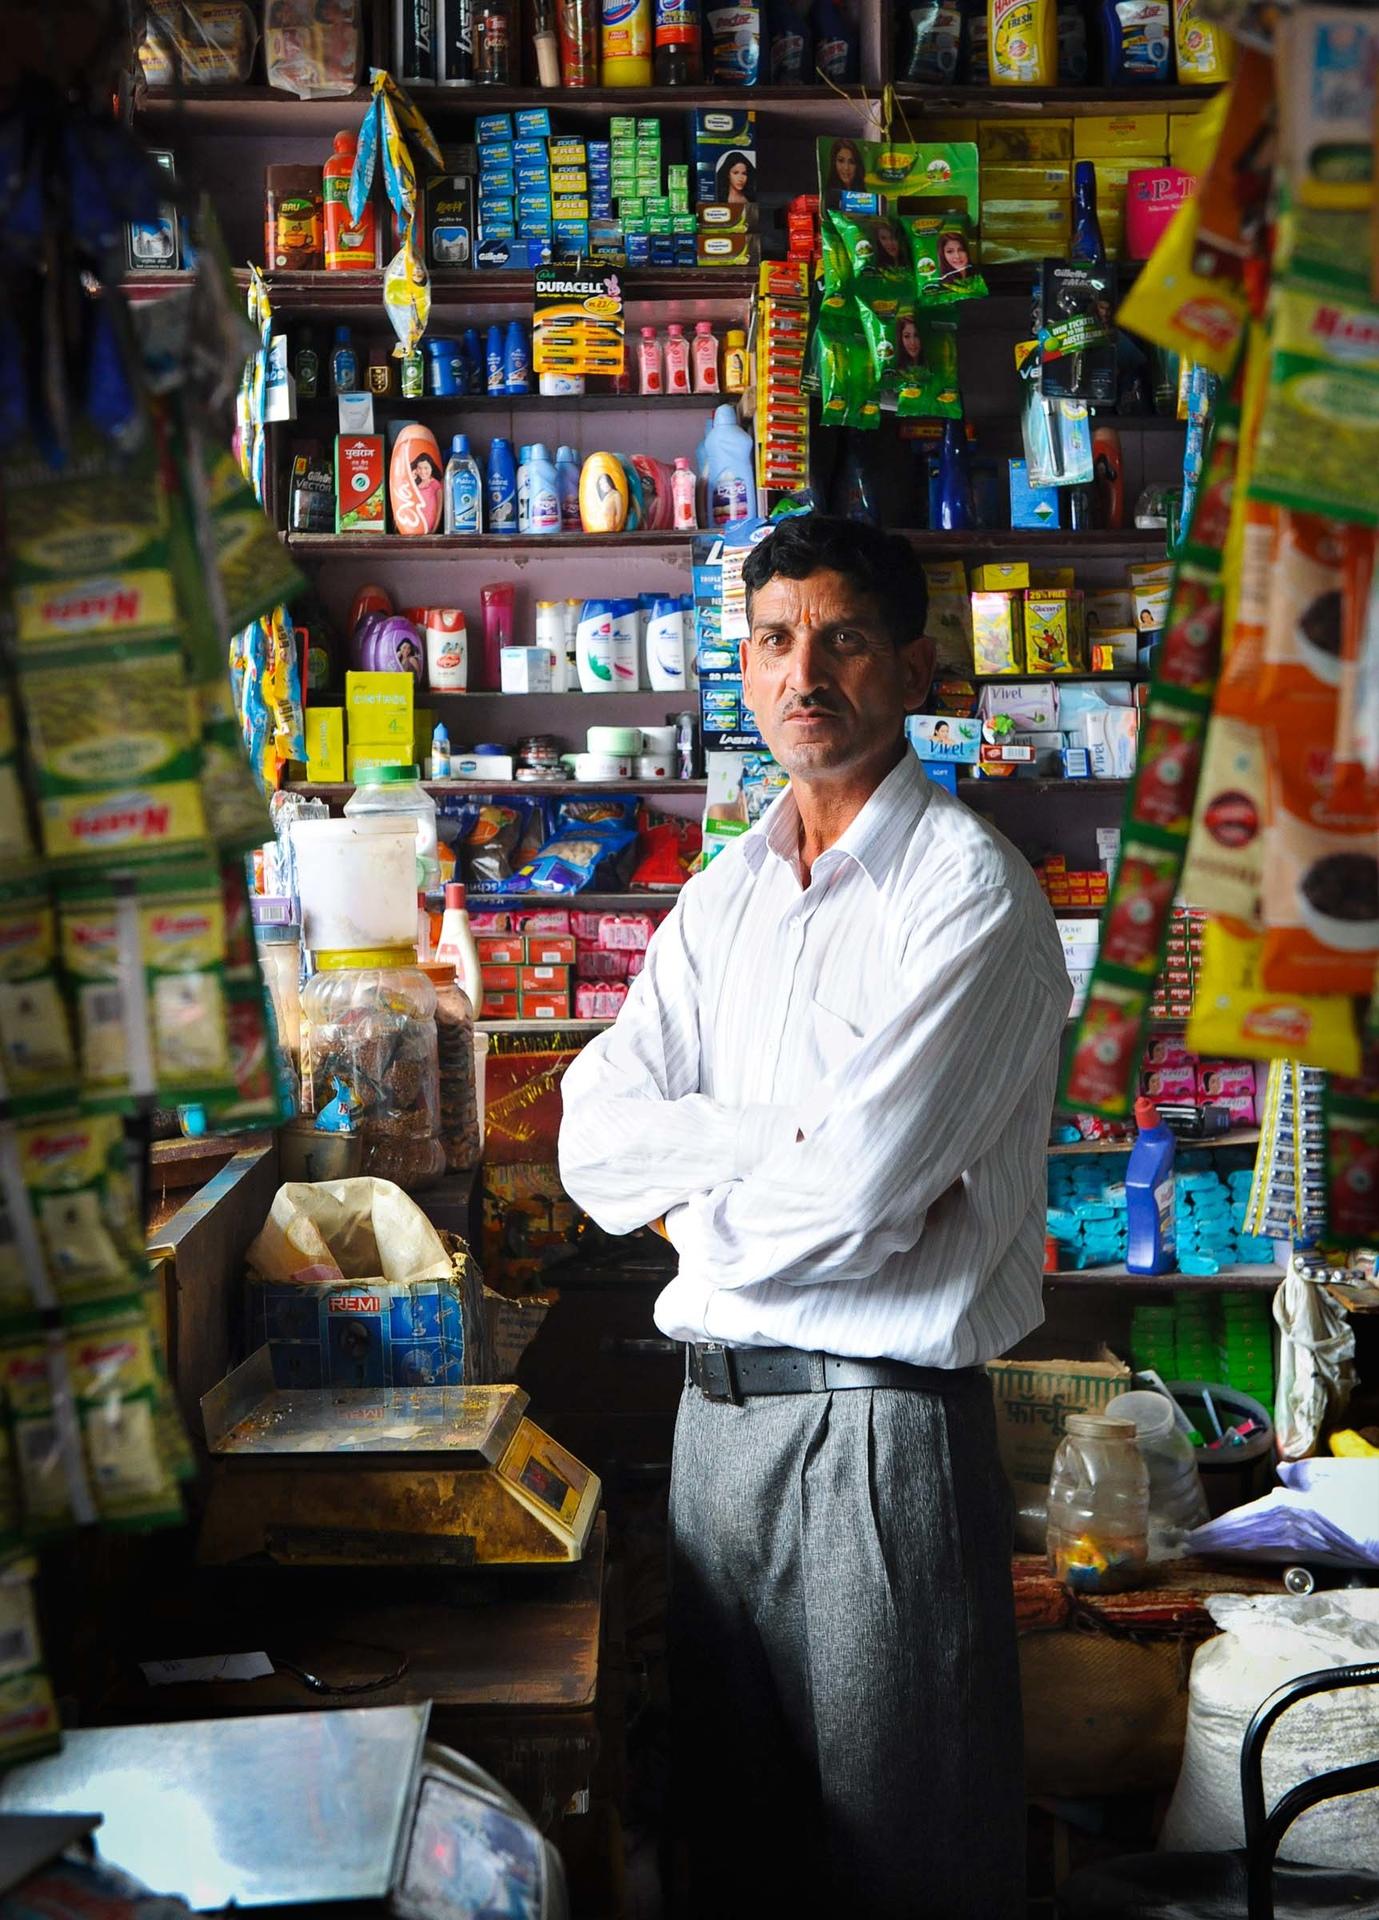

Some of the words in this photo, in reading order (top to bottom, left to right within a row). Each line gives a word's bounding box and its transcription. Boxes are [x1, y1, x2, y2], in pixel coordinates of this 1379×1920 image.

[536, 281, 604, 293] DURACELL
[723, 673, 742, 682] PAC
[990, 686, 1023, 700] Vivel
[719, 734, 758, 745] LASER
[928, 739, 965, 756] Vivel
[1094, 742, 1105, 775] Vivel
[330, 1298, 378, 1312] REMI
